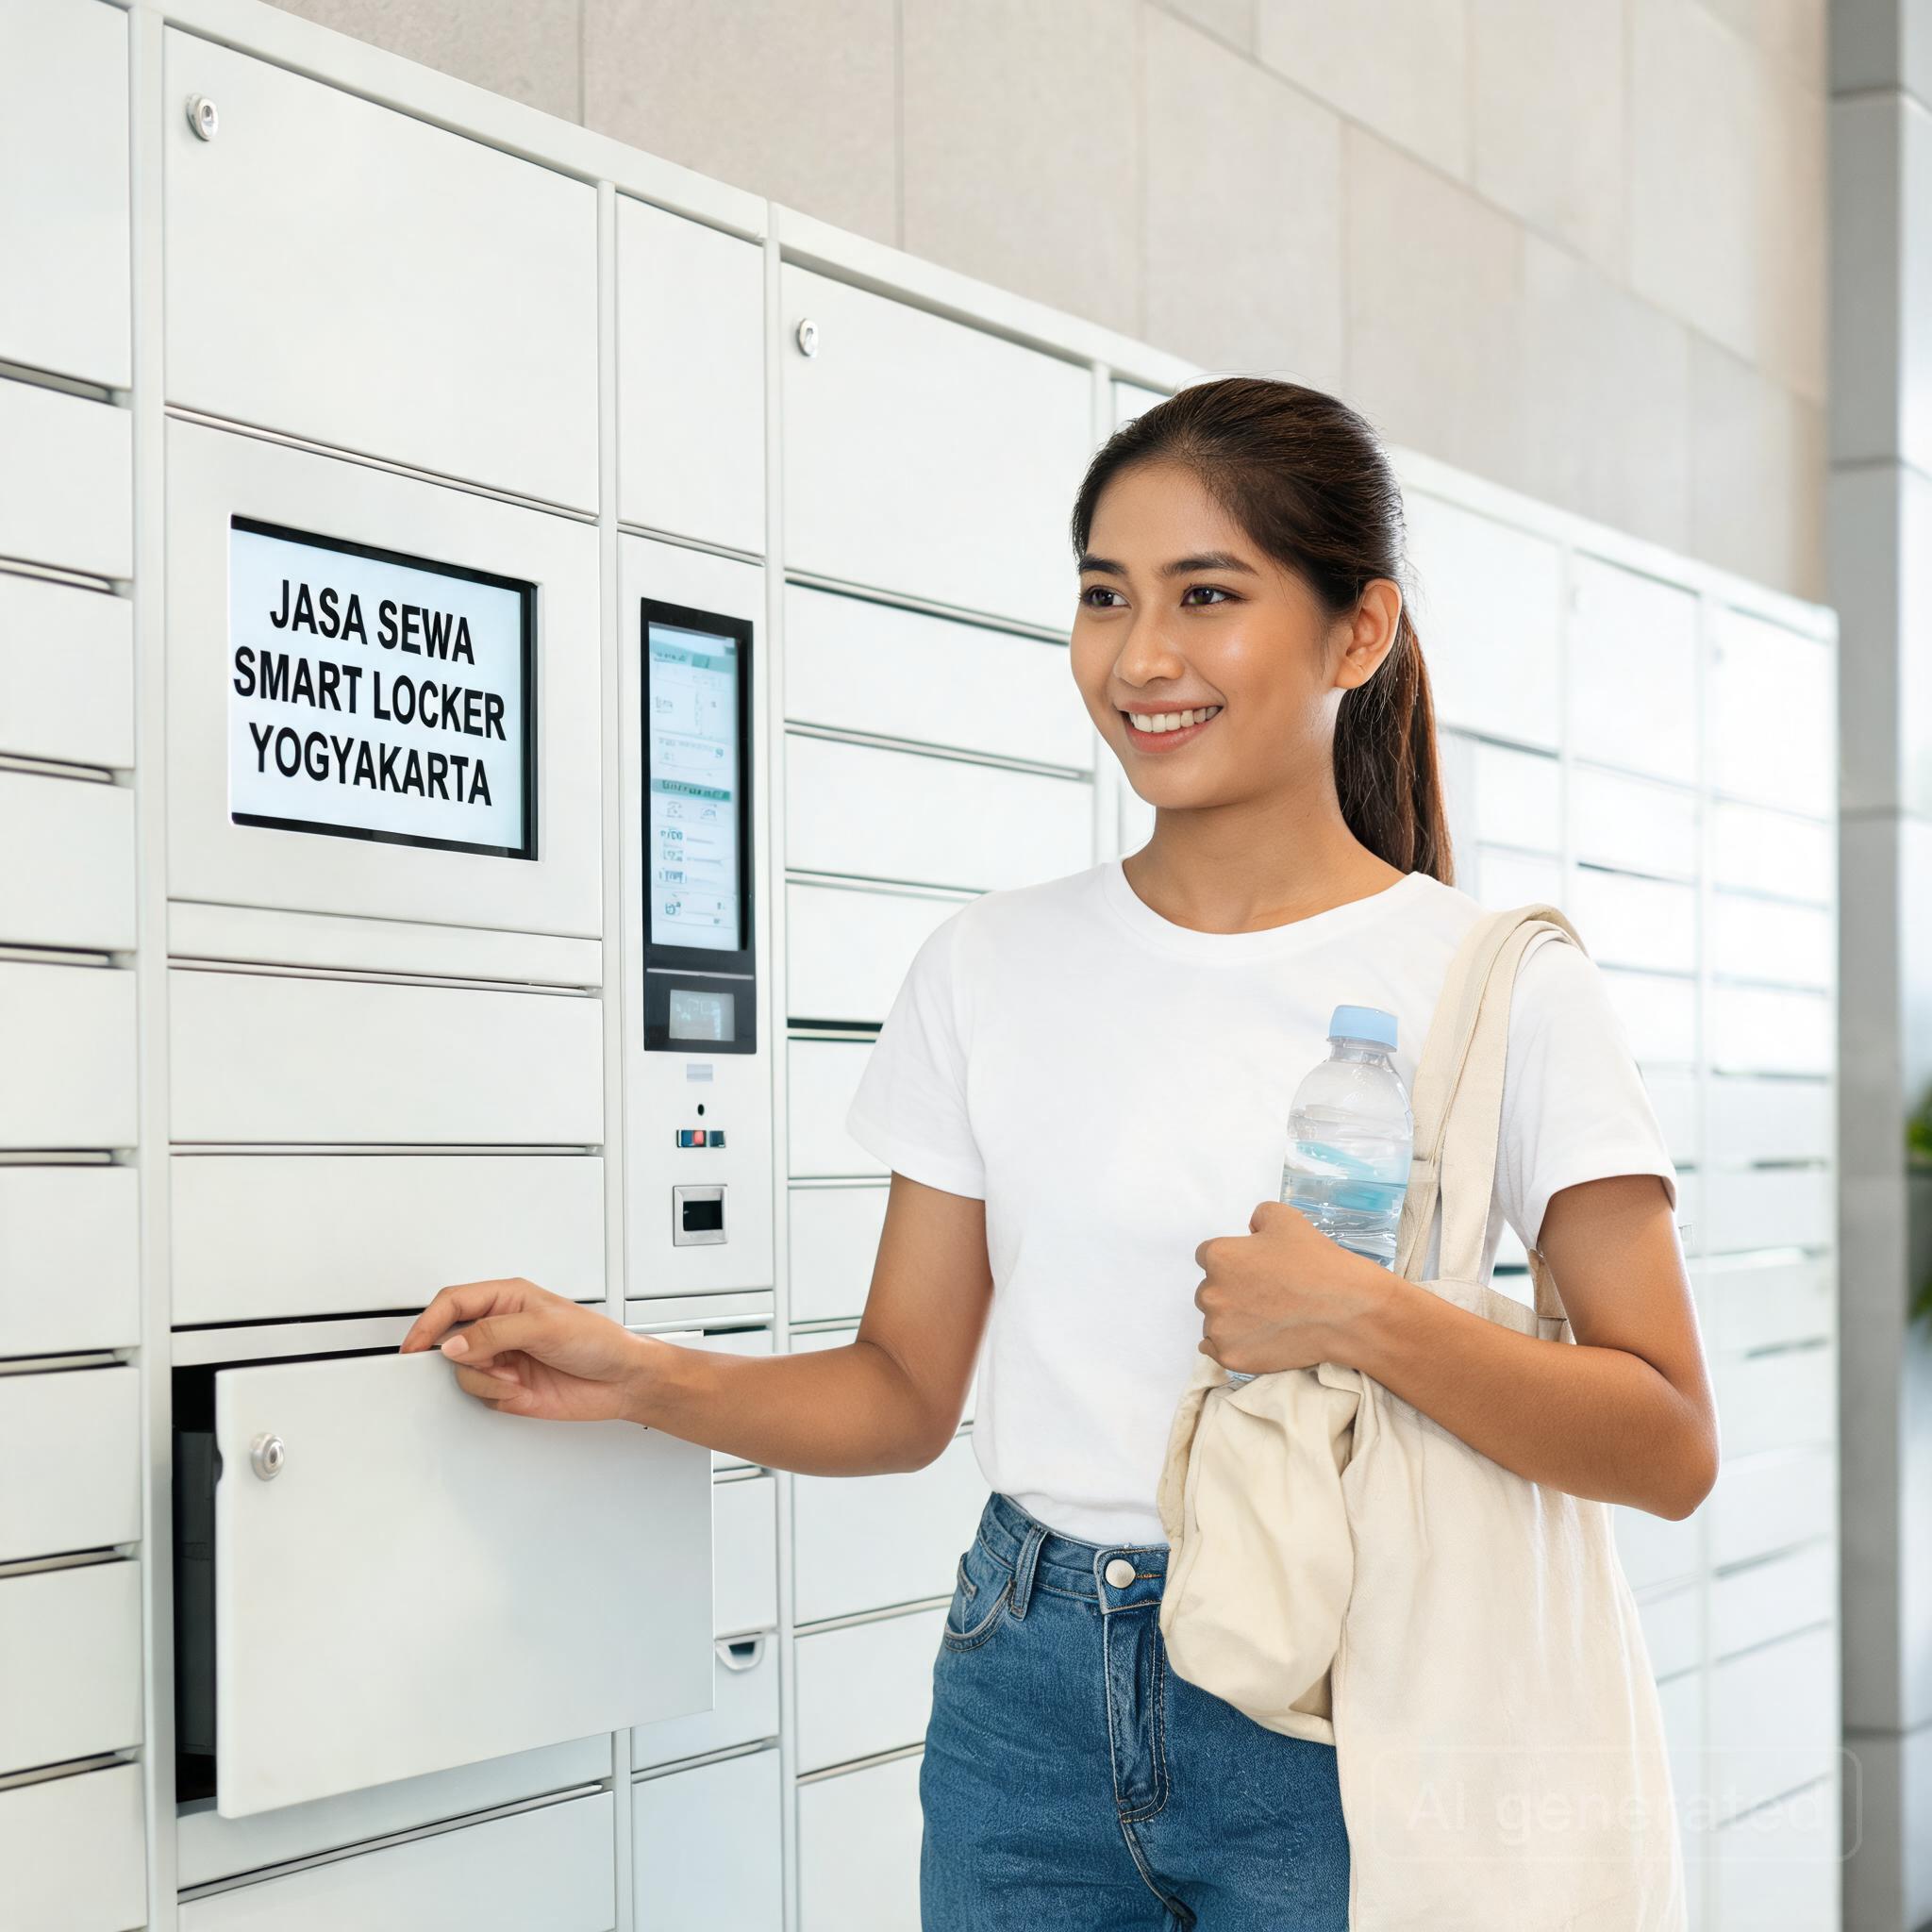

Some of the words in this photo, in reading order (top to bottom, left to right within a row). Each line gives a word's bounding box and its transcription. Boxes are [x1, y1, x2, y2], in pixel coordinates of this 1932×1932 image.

[270, 579, 368, 645] JASA
[377, 599, 475, 665] SEWA
[233, 645, 362, 714] SMART
[374, 670, 507, 741] LOCKER
[248, 722, 492, 807] YOGYAKARTA
